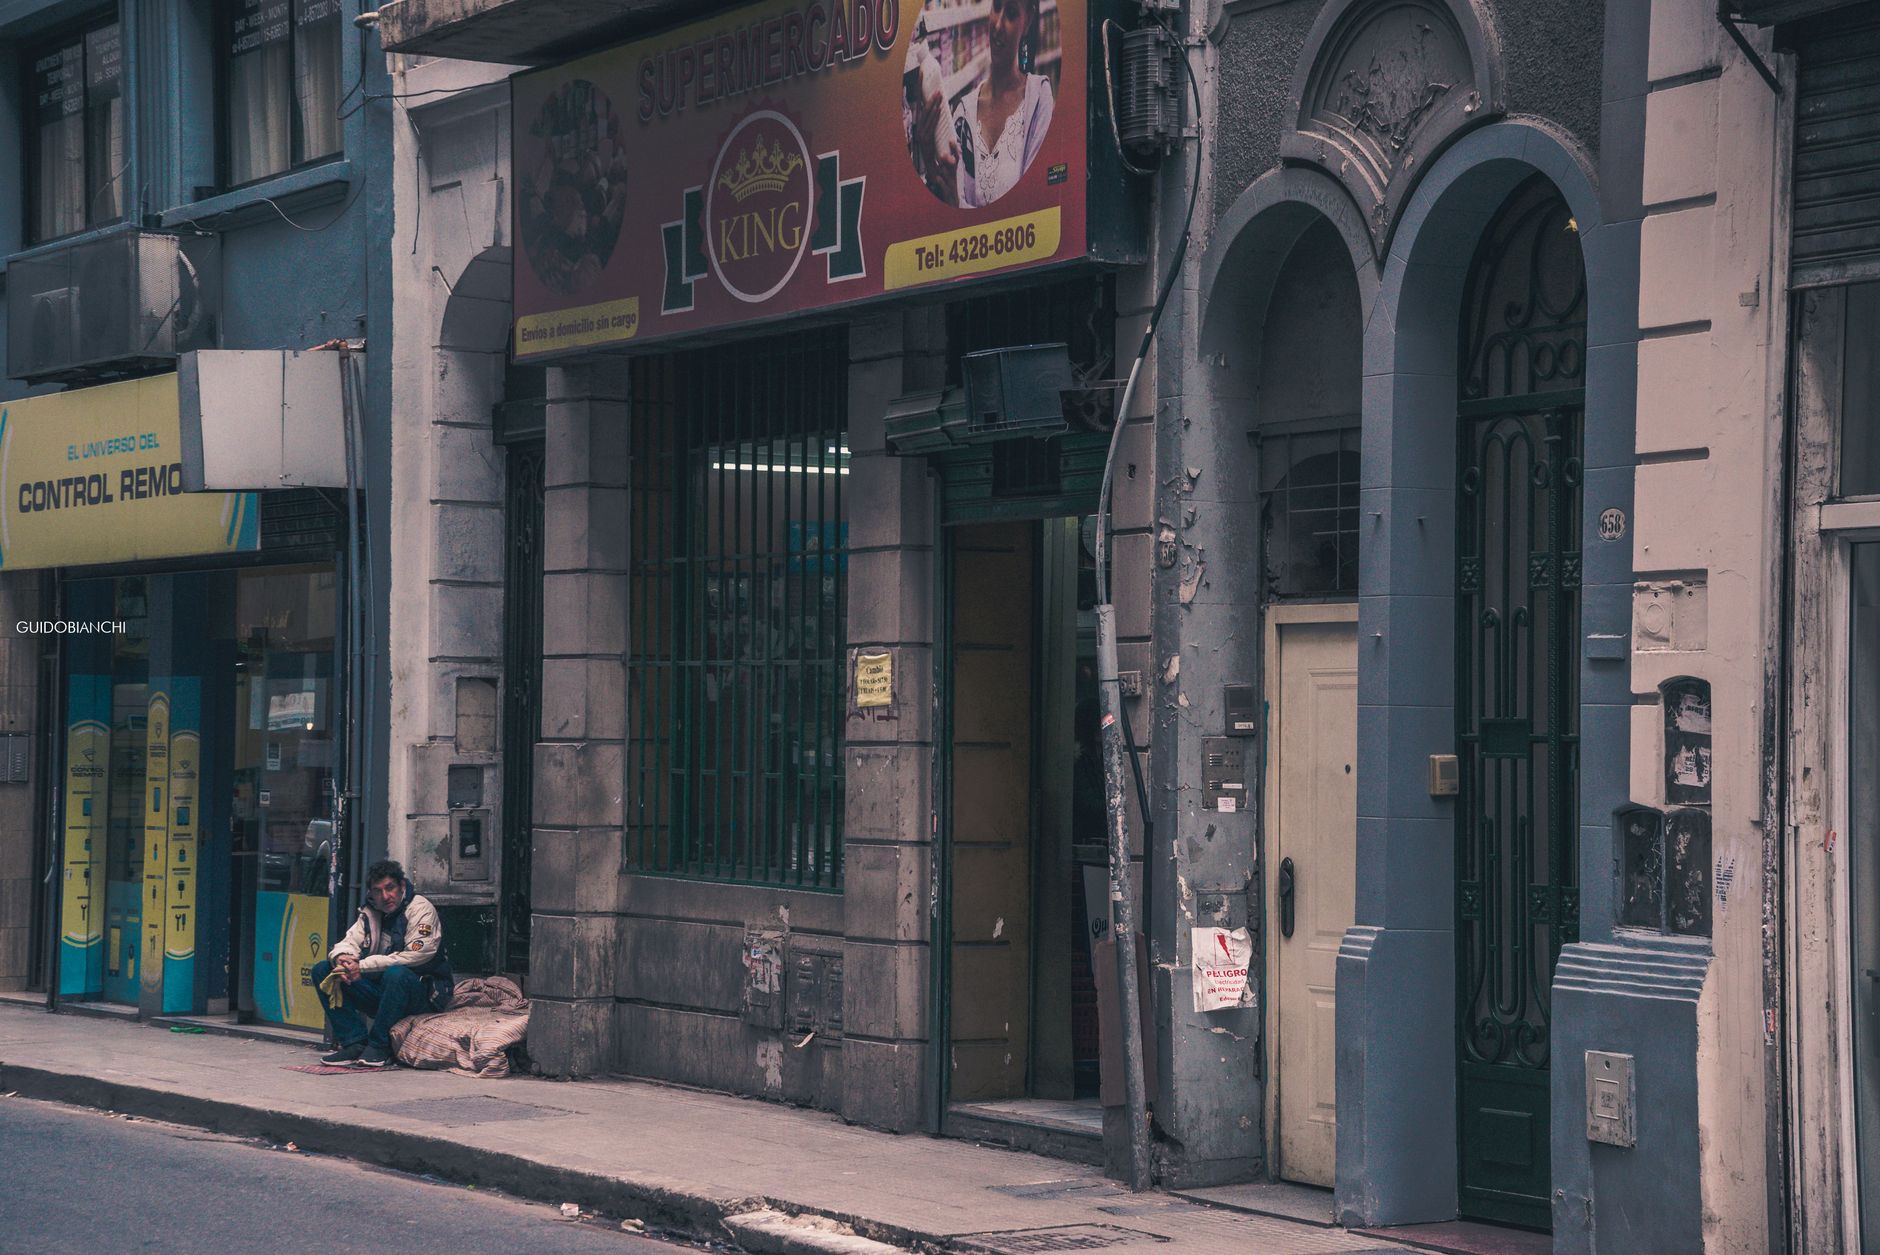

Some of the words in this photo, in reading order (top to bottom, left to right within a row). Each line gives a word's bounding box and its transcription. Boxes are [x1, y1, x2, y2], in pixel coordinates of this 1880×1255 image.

[639, 0, 900, 120] SUPERMERCADO
[719, 202, 801, 264] KING
[915, 244, 944, 271] Tel:
[949, 223, 1035, 264] 4328-6806
[550, 327, 555, 338] a
[557, 319, 593, 337] domicilio
[596, 315, 609, 331] sin
[611, 312, 636, 329] cargo
[67, 444, 79, 461] EL
[82, 436, 136, 459] UNIVERSO
[139, 433, 160, 450] DEL
[19, 473, 113, 513] CONTROL
[1602, 513, 1621, 534] 658
[1206, 968, 1247, 978] PELIGRO
